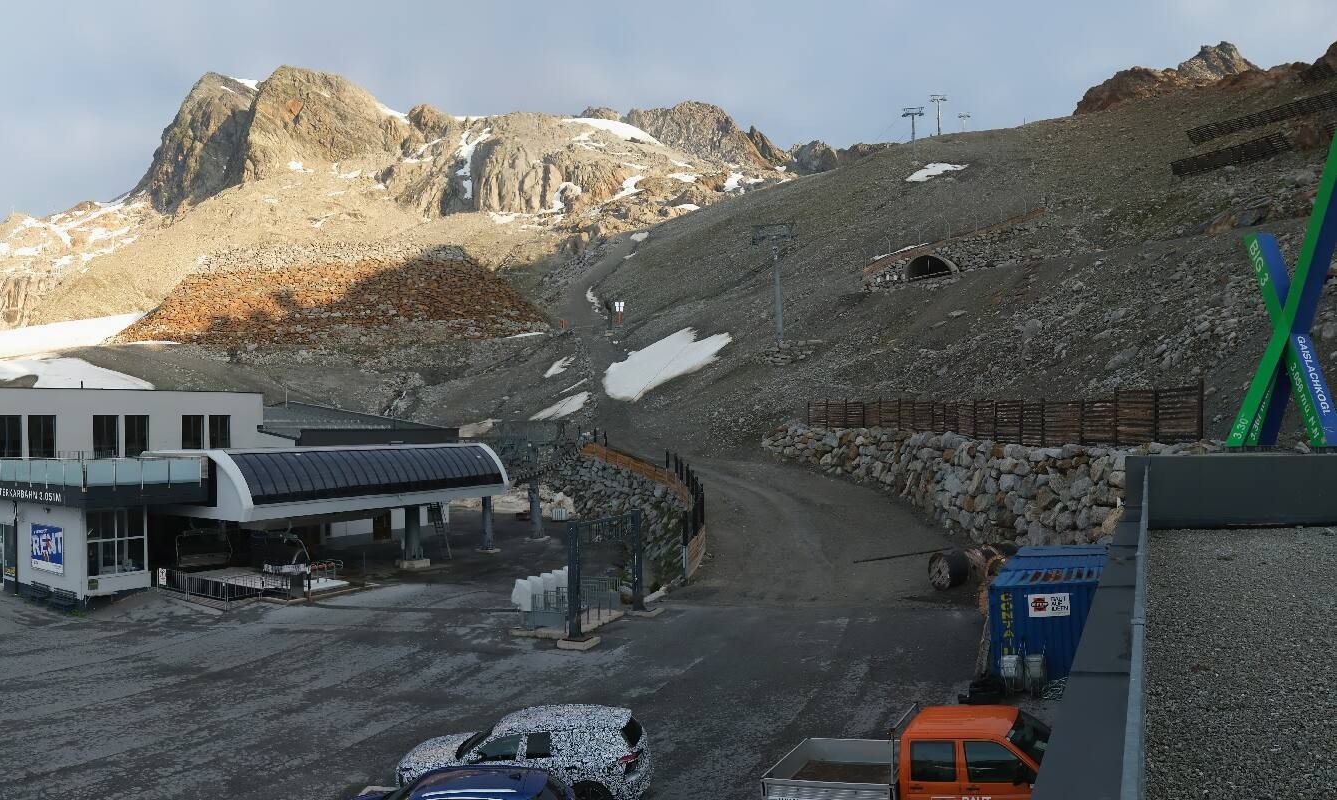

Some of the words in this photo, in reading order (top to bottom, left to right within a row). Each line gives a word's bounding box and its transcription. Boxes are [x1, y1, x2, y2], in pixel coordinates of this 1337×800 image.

[1249, 239, 1265, 272] BIG
[1259, 274, 1269, 287] 3
[1297, 335, 1331, 416] GAISLACHKOGL
[1232, 414, 1249, 440] 3.30
[31, 532, 63, 556] RENT
